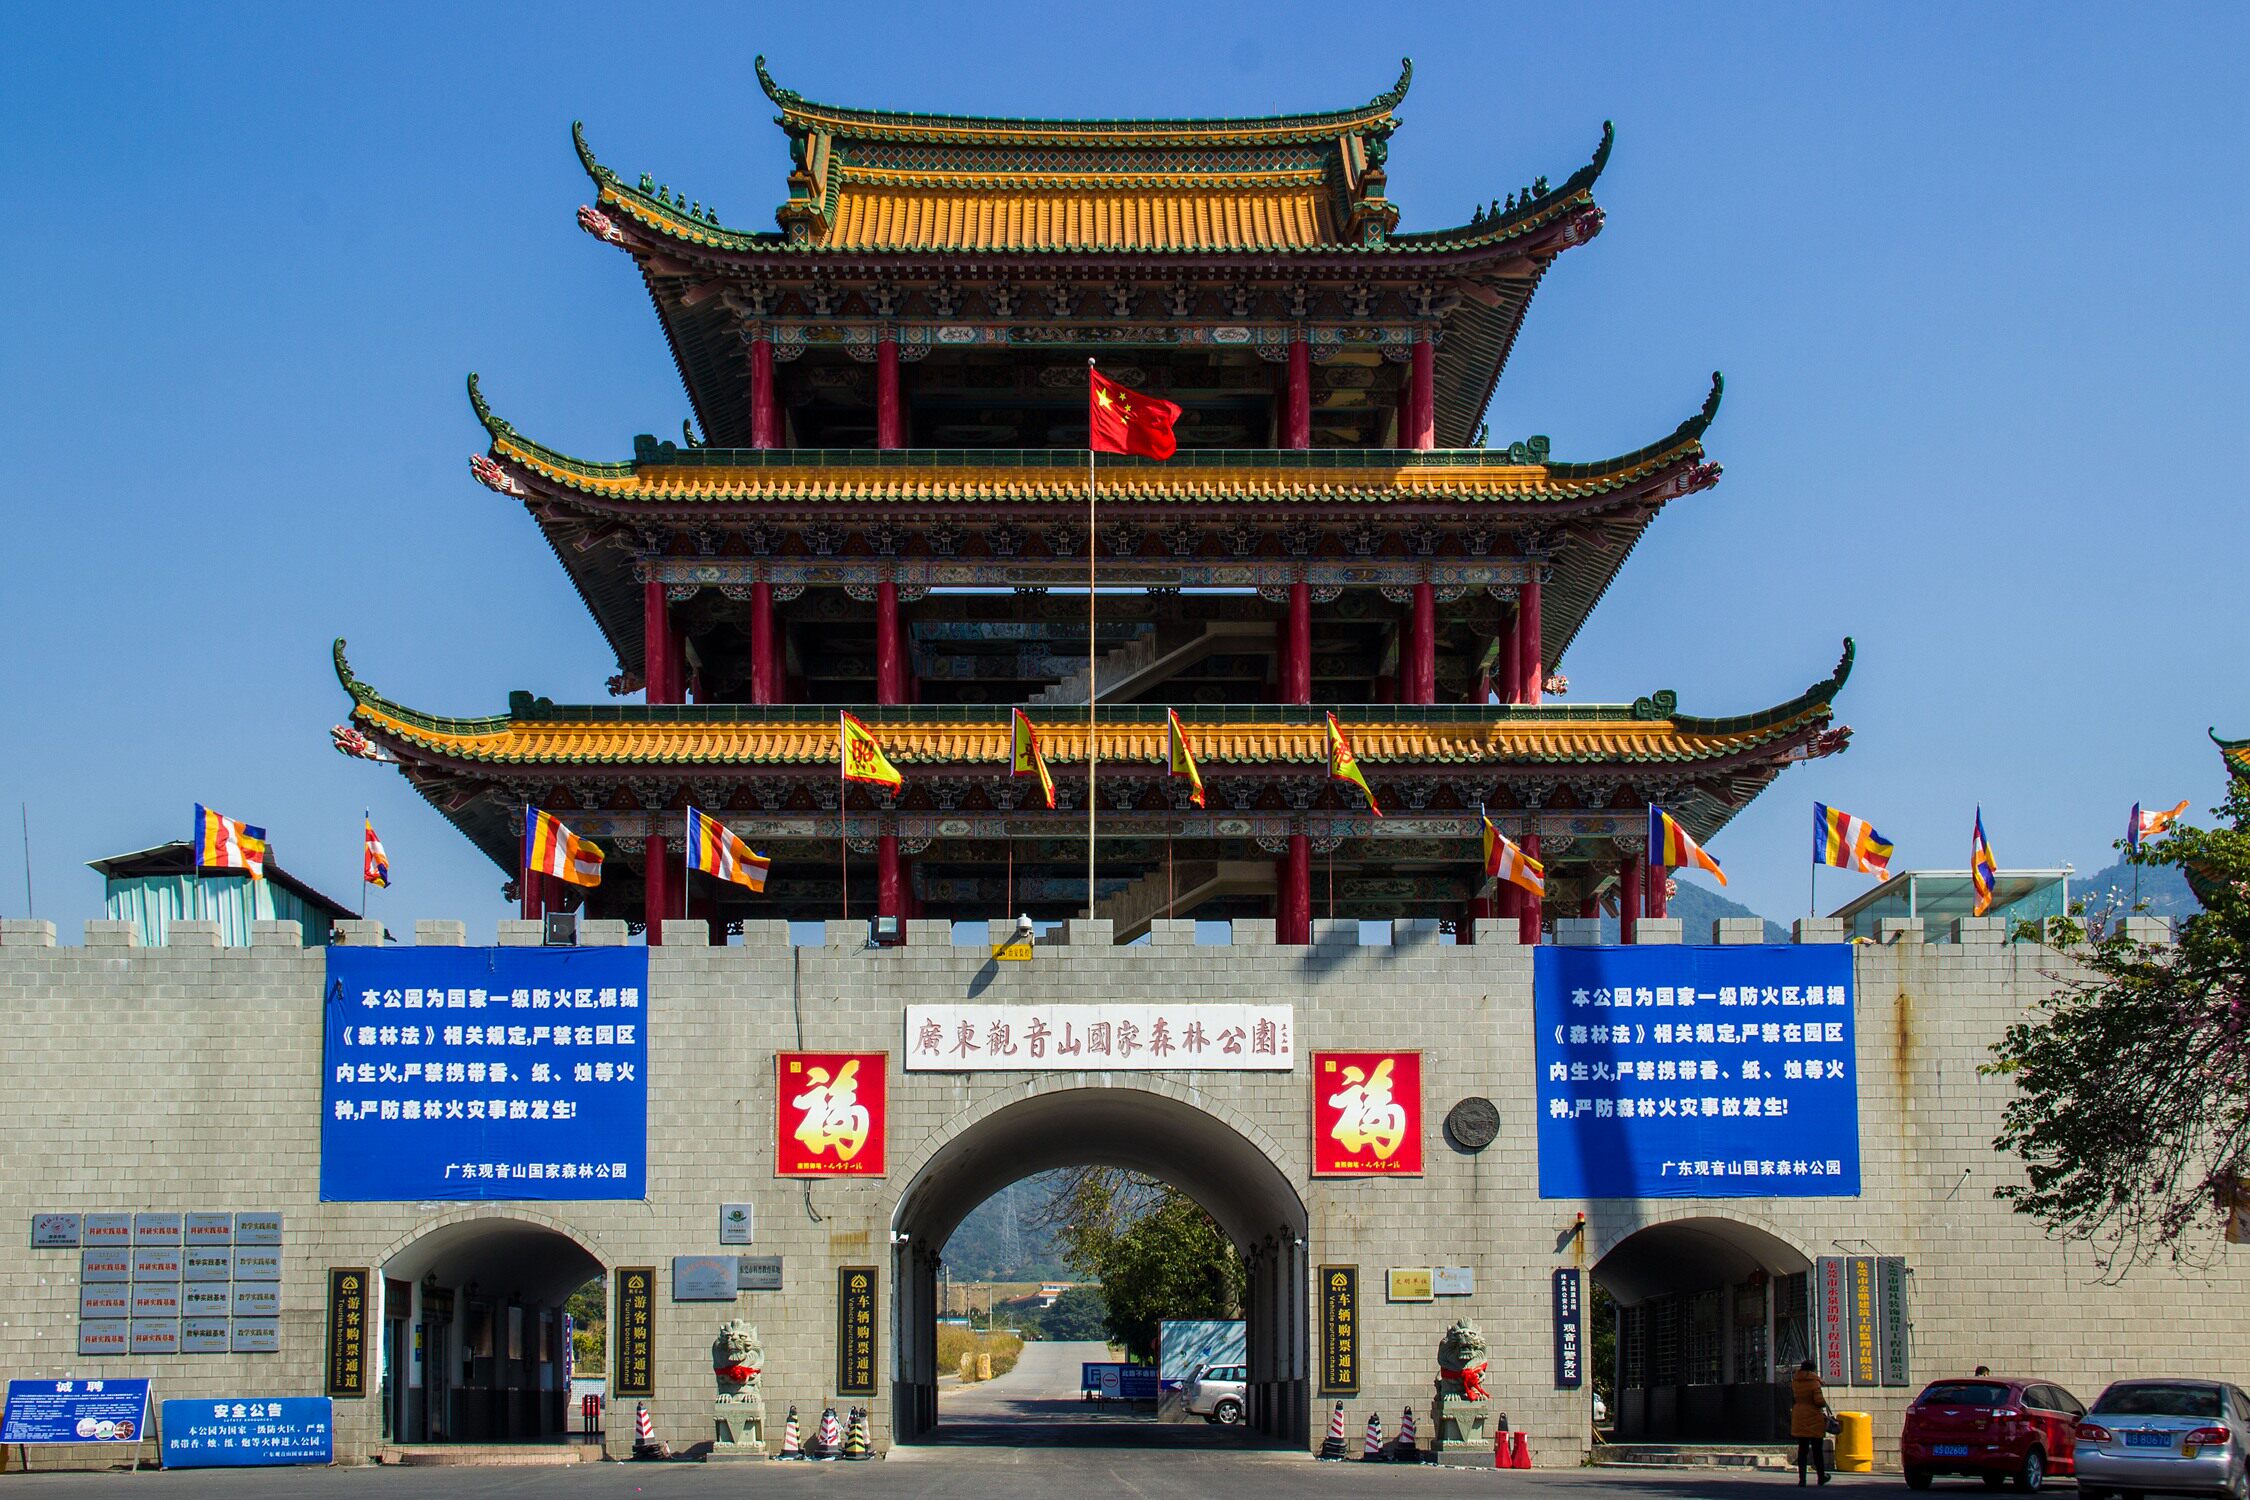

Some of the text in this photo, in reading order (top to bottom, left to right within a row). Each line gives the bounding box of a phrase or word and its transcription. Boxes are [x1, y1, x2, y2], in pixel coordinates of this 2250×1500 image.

[850, 738, 876, 773] 照
[912, 1017, 1277, 1059] 廣東觀音山國家森林公園
[792, 1060, 869, 1161] 福
[1328, 1058, 1406, 1160] 福
[444, 1163, 627, 1179] 广东观音山国家森林公园
[1661, 1160, 1841, 1176] 广东观音山国家森林公园
[89, 1227, 128, 1235] 科研实践基地
[190, 1226, 229, 1234] 科研实践基地
[241, 1222, 278, 1230] 教学实践基地
[87, 1263, 126, 1272] 科研实践基地
[139, 1263, 177, 1271] 科研实践基地
[137, 1299, 176, 1307] 科研实践基地
[239, 1293, 276, 1301] 教学实践基地
[86, 1299, 125, 1308] 科研实践基地
[136, 1334, 174, 1342] 科研实践基地
[187, 1329, 225, 1337] 教学实践基地
[238, 1328, 274, 1336] 教学实践基地
[1338, 1293, 1351, 1383] 车辆购票通道
[85, 1335, 124, 1343] 科研实践基地
[345, 1296, 360, 1387] 游客购票通道
[633, 1295, 646, 1386] 游客购票通道
[857, 1294, 870, 1385] 车辆购票通道
[1563, 1324, 1577, 1378] 观音山警务区
[214, 1403, 282, 1418] 安全公告
